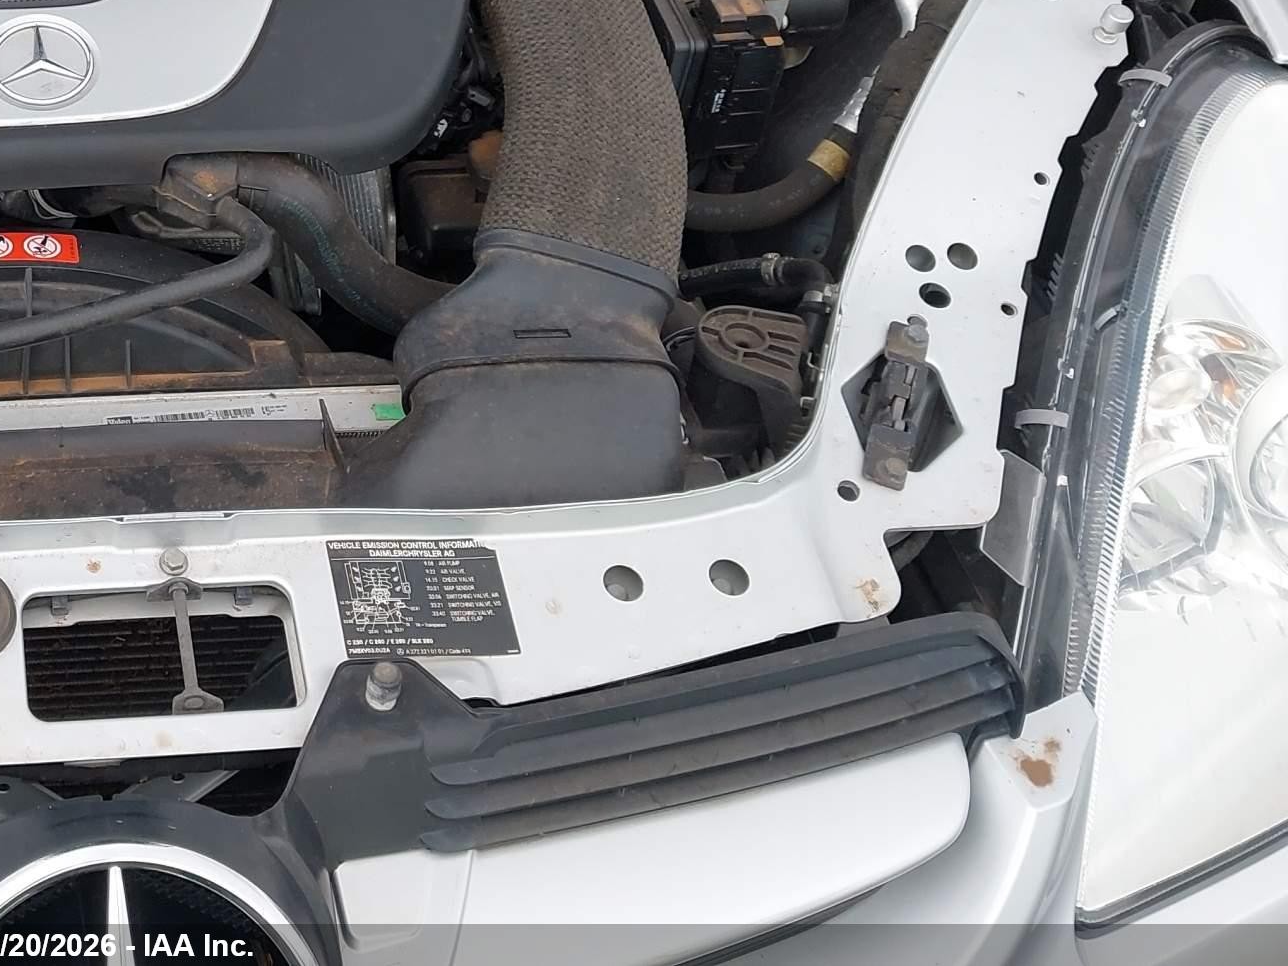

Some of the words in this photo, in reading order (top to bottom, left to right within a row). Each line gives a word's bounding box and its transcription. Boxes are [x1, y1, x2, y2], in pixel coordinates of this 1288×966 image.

[328, 542, 361, 550] VEHICLE
[362, 541, 400, 549] EMISSION
[401, 541, 438, 549] CONTROL
